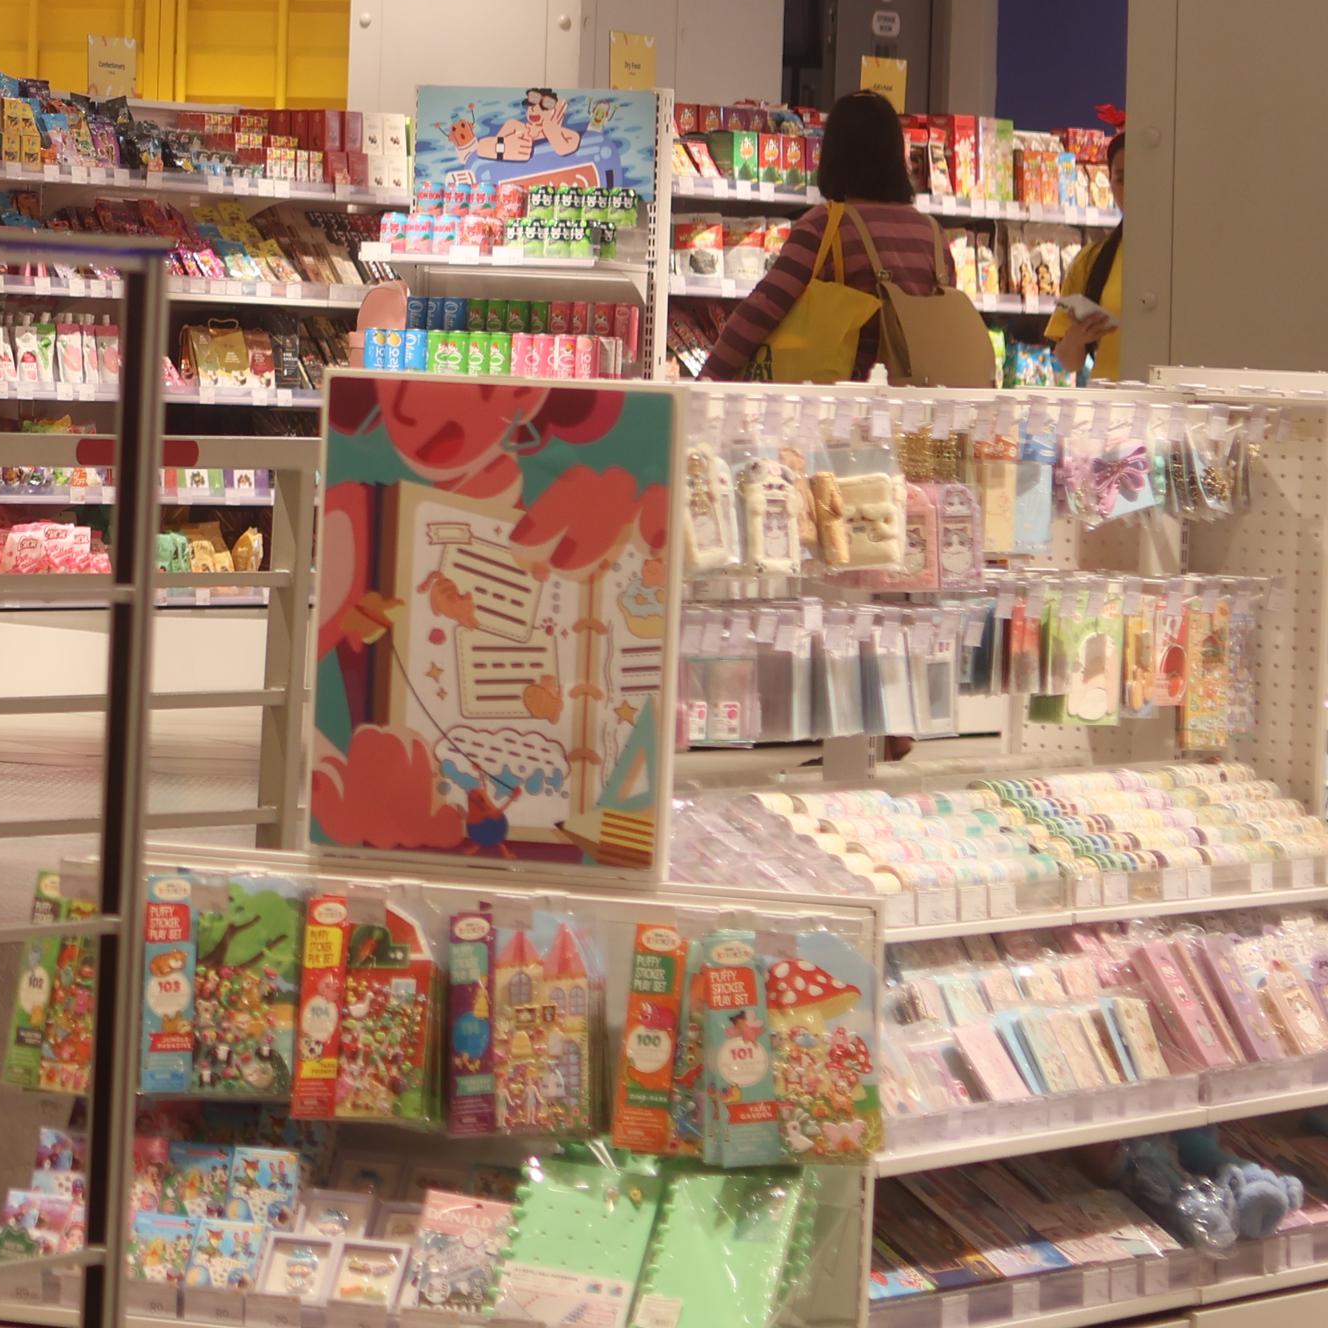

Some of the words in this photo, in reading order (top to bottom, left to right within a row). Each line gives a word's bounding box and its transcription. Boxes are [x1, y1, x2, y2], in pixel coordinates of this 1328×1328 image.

[149, 905, 175, 917] PUFFY
[149, 916, 179, 929] STICKER
[148, 928, 166, 941] PLAY
[167, 928, 184, 940] SET
[635, 954, 662, 968] PUFFY
[635, 967, 666, 981] STICKER
[710, 971, 736, 983] PUFFY
[157, 980, 181, 993] 103
[633, 980, 652, 992] PLAY
[652, 980, 668, 993] SET
[711, 982, 745, 995] STICKER
[712, 994, 733, 1007] PLAY
[734, 993, 750, 1006] SET
[636, 1034, 662, 1047] 100
[730, 1048, 754, 1060] 101
